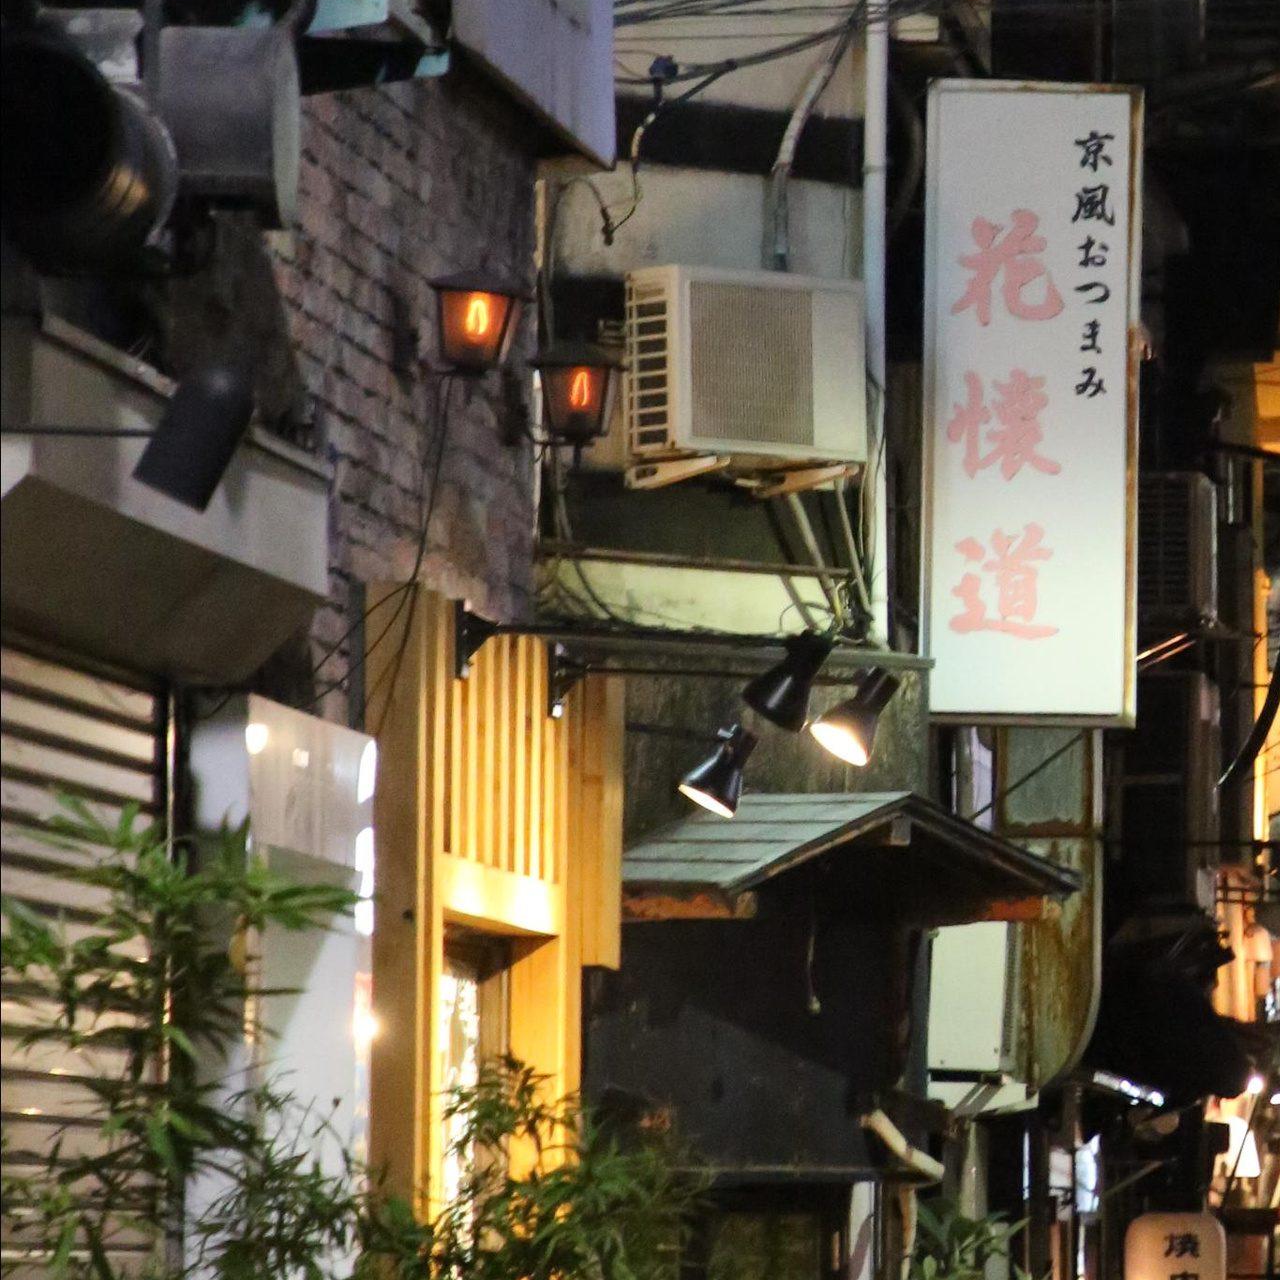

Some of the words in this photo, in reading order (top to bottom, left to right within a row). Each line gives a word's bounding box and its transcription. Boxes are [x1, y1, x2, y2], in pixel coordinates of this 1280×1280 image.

[1072, 130, 1116, 398] 京風おつまみ
